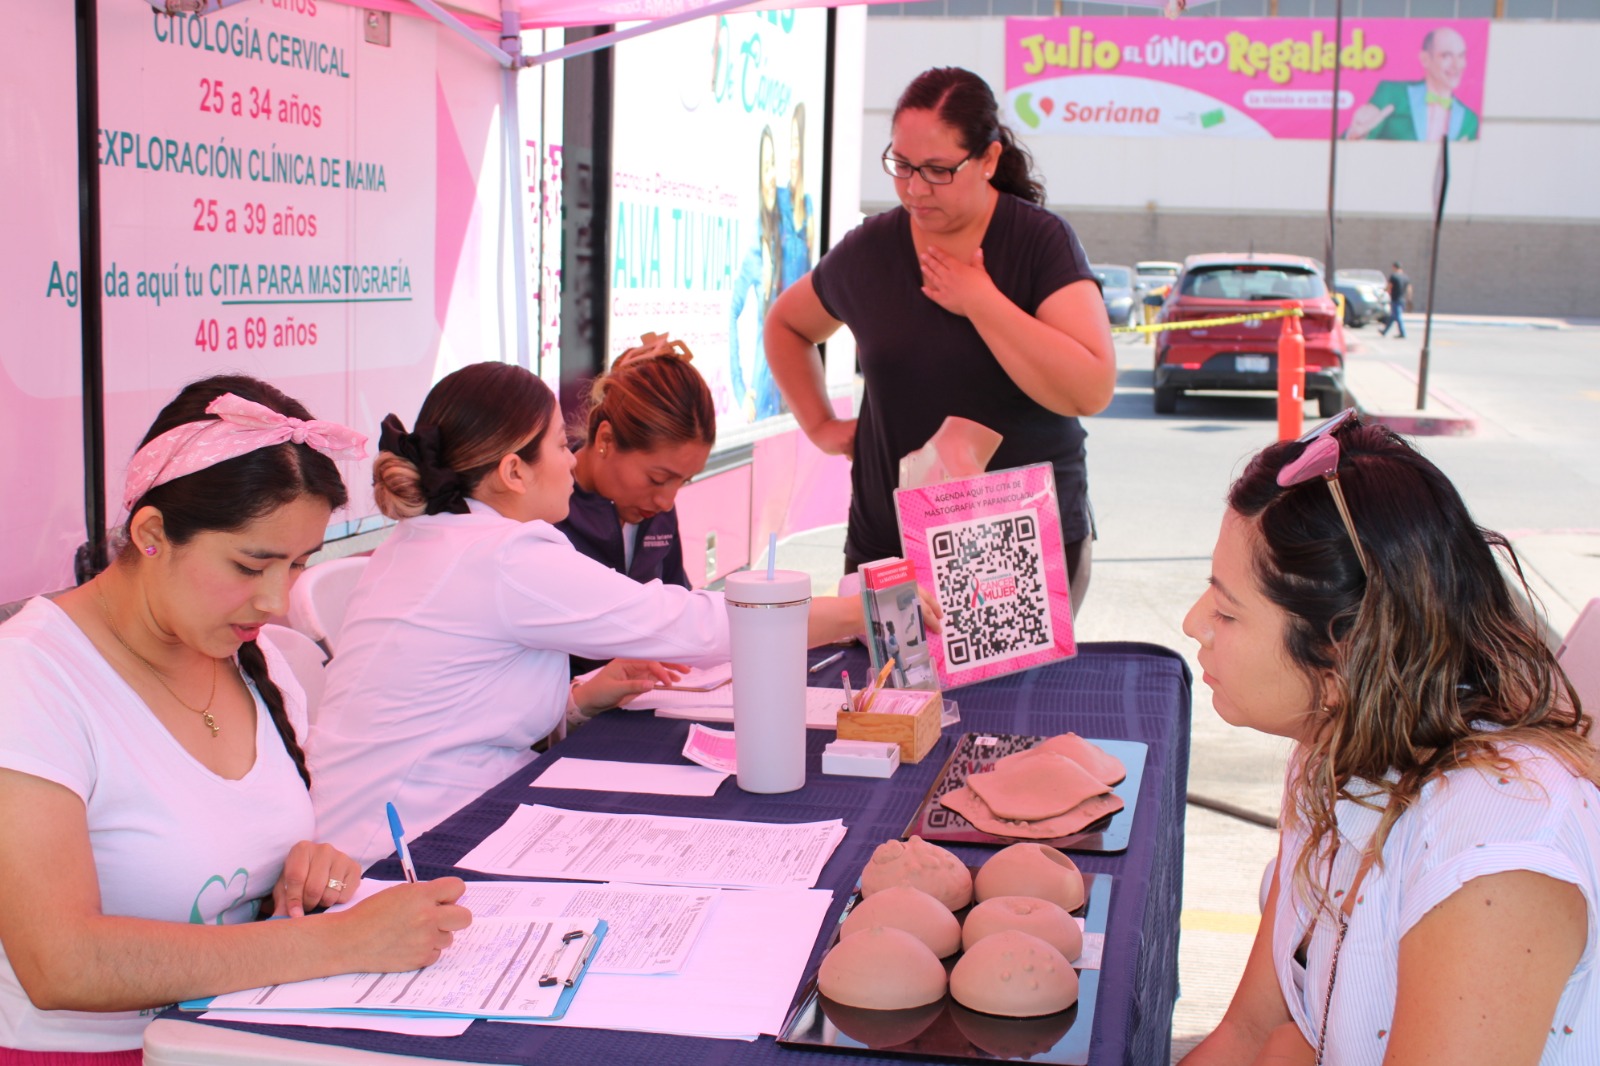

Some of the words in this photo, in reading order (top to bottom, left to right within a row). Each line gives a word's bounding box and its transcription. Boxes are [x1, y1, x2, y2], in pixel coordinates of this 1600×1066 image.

[153, 12, 263, 61] CITOLOGÍA
[267, 32, 350, 78] CERVICAL
[1020, 26, 1121, 75] Julio
[1123, 46, 1143, 63] EL
[1145, 35, 1225, 68] ÚNICO
[1226, 28, 1385, 84] Regalado
[199, 77, 224, 114] 25
[231, 90, 242, 116] a
[249, 86, 271, 120] 34
[278, 93, 322, 128] años
[1063, 100, 1160, 124] Soriana
[248, 142, 316, 186] CLÍNICA
[320, 157, 341, 188] DE
[193, 198, 218, 231] 25
[225, 208, 236, 233] a
[243, 202, 267, 235] 39
[272, 205, 317, 237] años
[613, 201, 660, 289] ALVA
[672, 208, 694, 289] TU
[46, 260, 129, 307] Agda
[136, 263, 179, 306] aquí
[185, 266, 203, 296] tu
[209, 263, 252, 296] CITA
[257, 264, 304, 295] PARA
[308, 258, 412, 295] MASTOGRAFÍA
[195, 318, 220, 352] 40
[227, 325, 238, 351] a
[244, 317, 267, 349] 69
[273, 316, 318, 347] años
[935, 492, 965, 503] AGENDA
[985, 485, 995, 494] TU
[996, 483, 1011, 492] CITA
[1012, 480, 1022, 489] DE
[976, 500, 982, 509] Y
[983, 586, 1016, 602] MUJER
